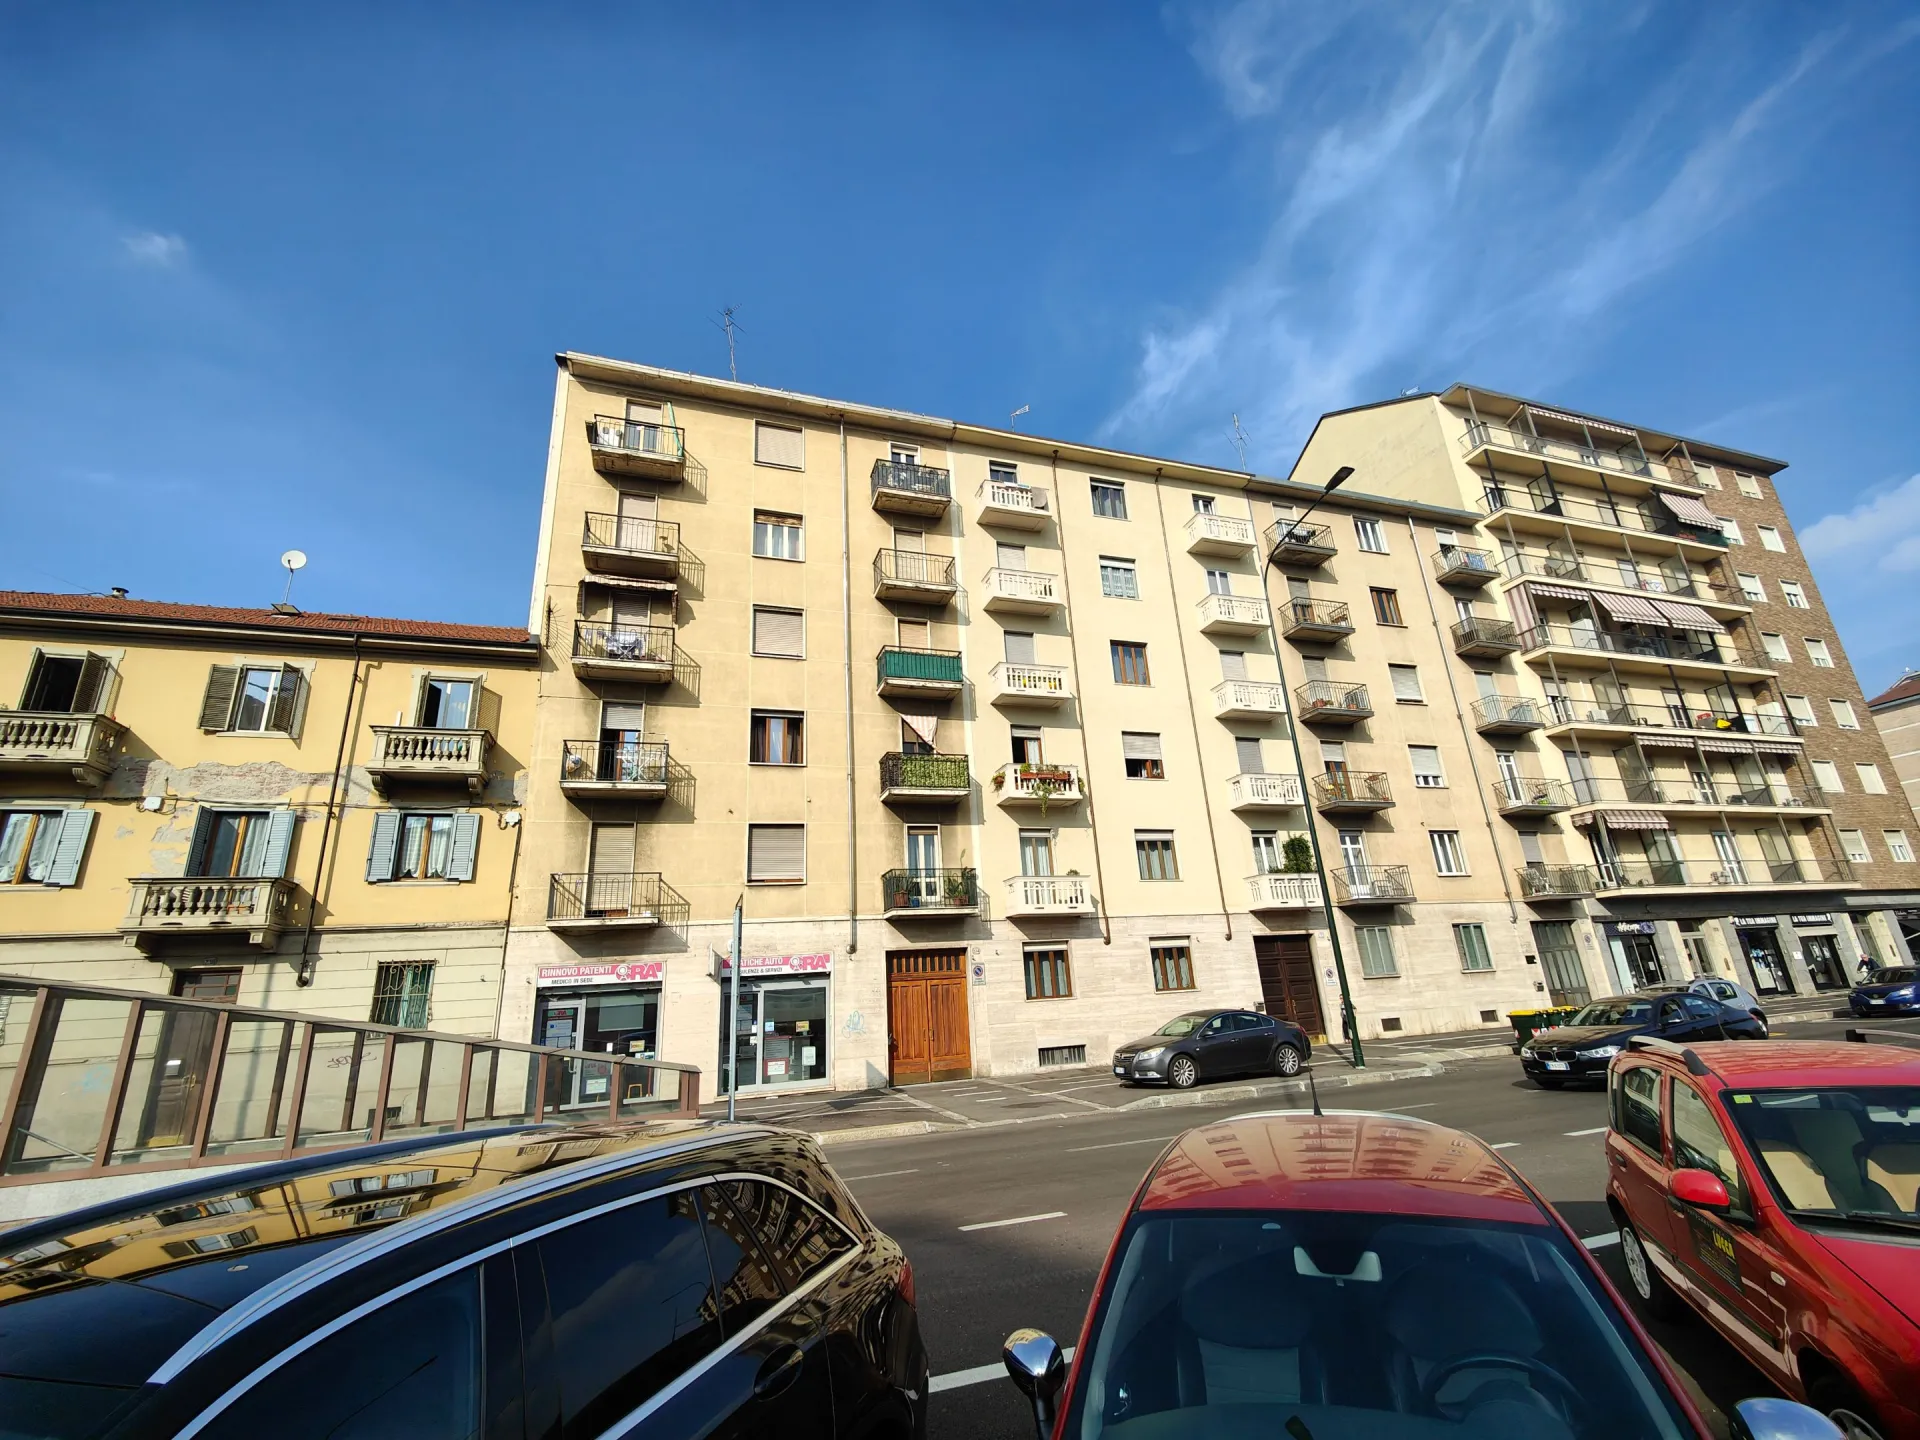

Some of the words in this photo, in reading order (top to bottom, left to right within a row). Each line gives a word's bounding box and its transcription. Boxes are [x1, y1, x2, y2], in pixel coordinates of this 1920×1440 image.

[730, 958, 763, 967] PATICHE
[764, 957, 783, 965] AUTO
[541, 967, 578, 977] RINNOVO
[579, 966, 612, 975] PATENTI
